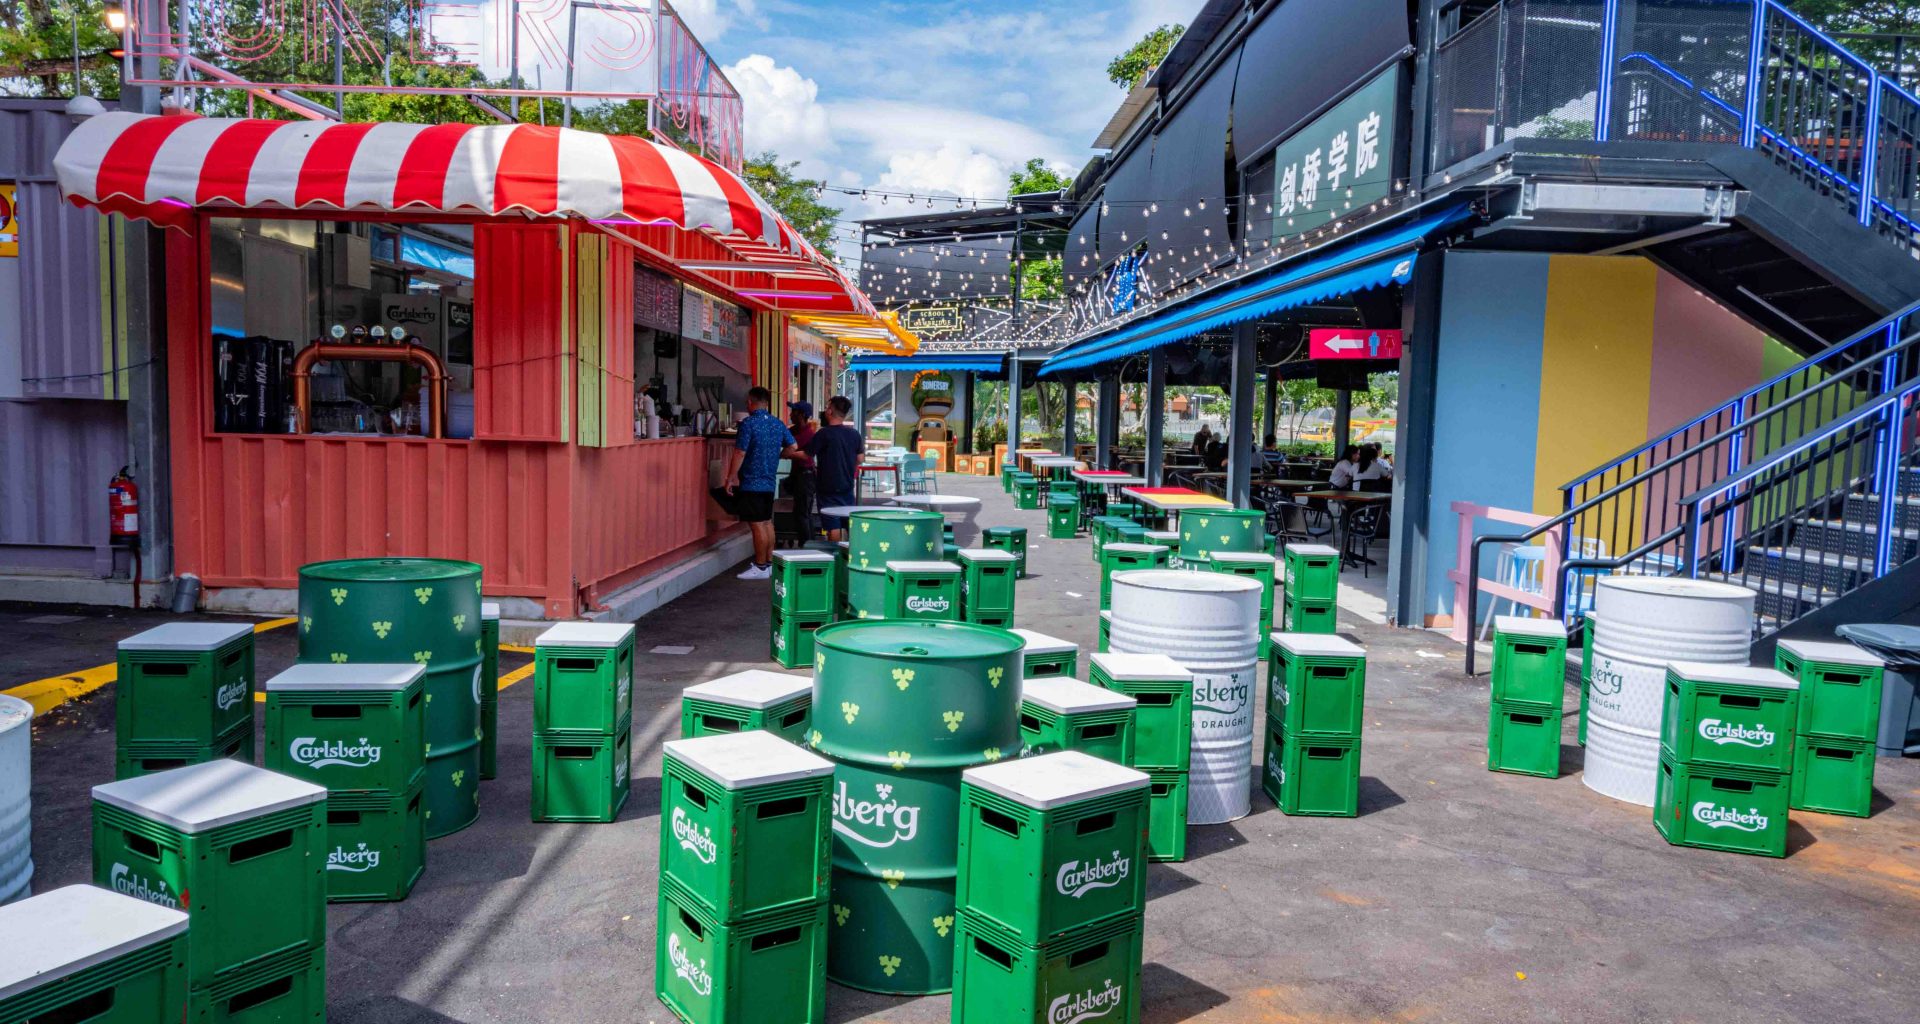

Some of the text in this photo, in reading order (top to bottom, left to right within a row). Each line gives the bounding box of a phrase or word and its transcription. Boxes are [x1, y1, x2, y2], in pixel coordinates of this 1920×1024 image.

[1279, 111, 1381, 217] 剑桥学院
[387, 305, 436, 324] Carlsberg
[906, 596, 950, 612] Carlsberg
[217, 677, 247, 709] Carlsberg
[1195, 674, 1249, 707] sberg
[1201, 716, 1248, 729] DRAUGHT
[1698, 718, 1775, 747] Carlsberg
[290, 737, 382, 766] Carlsberg
[832, 783, 920, 842] sberg
[1692, 801, 1769, 830] Carlsberg
[672, 806, 717, 863] Carlsberg
[327, 845, 380, 869] sberg
[1056, 850, 1130, 898] Carlsberg
[1048, 979, 1122, 1024] Carlsberg
